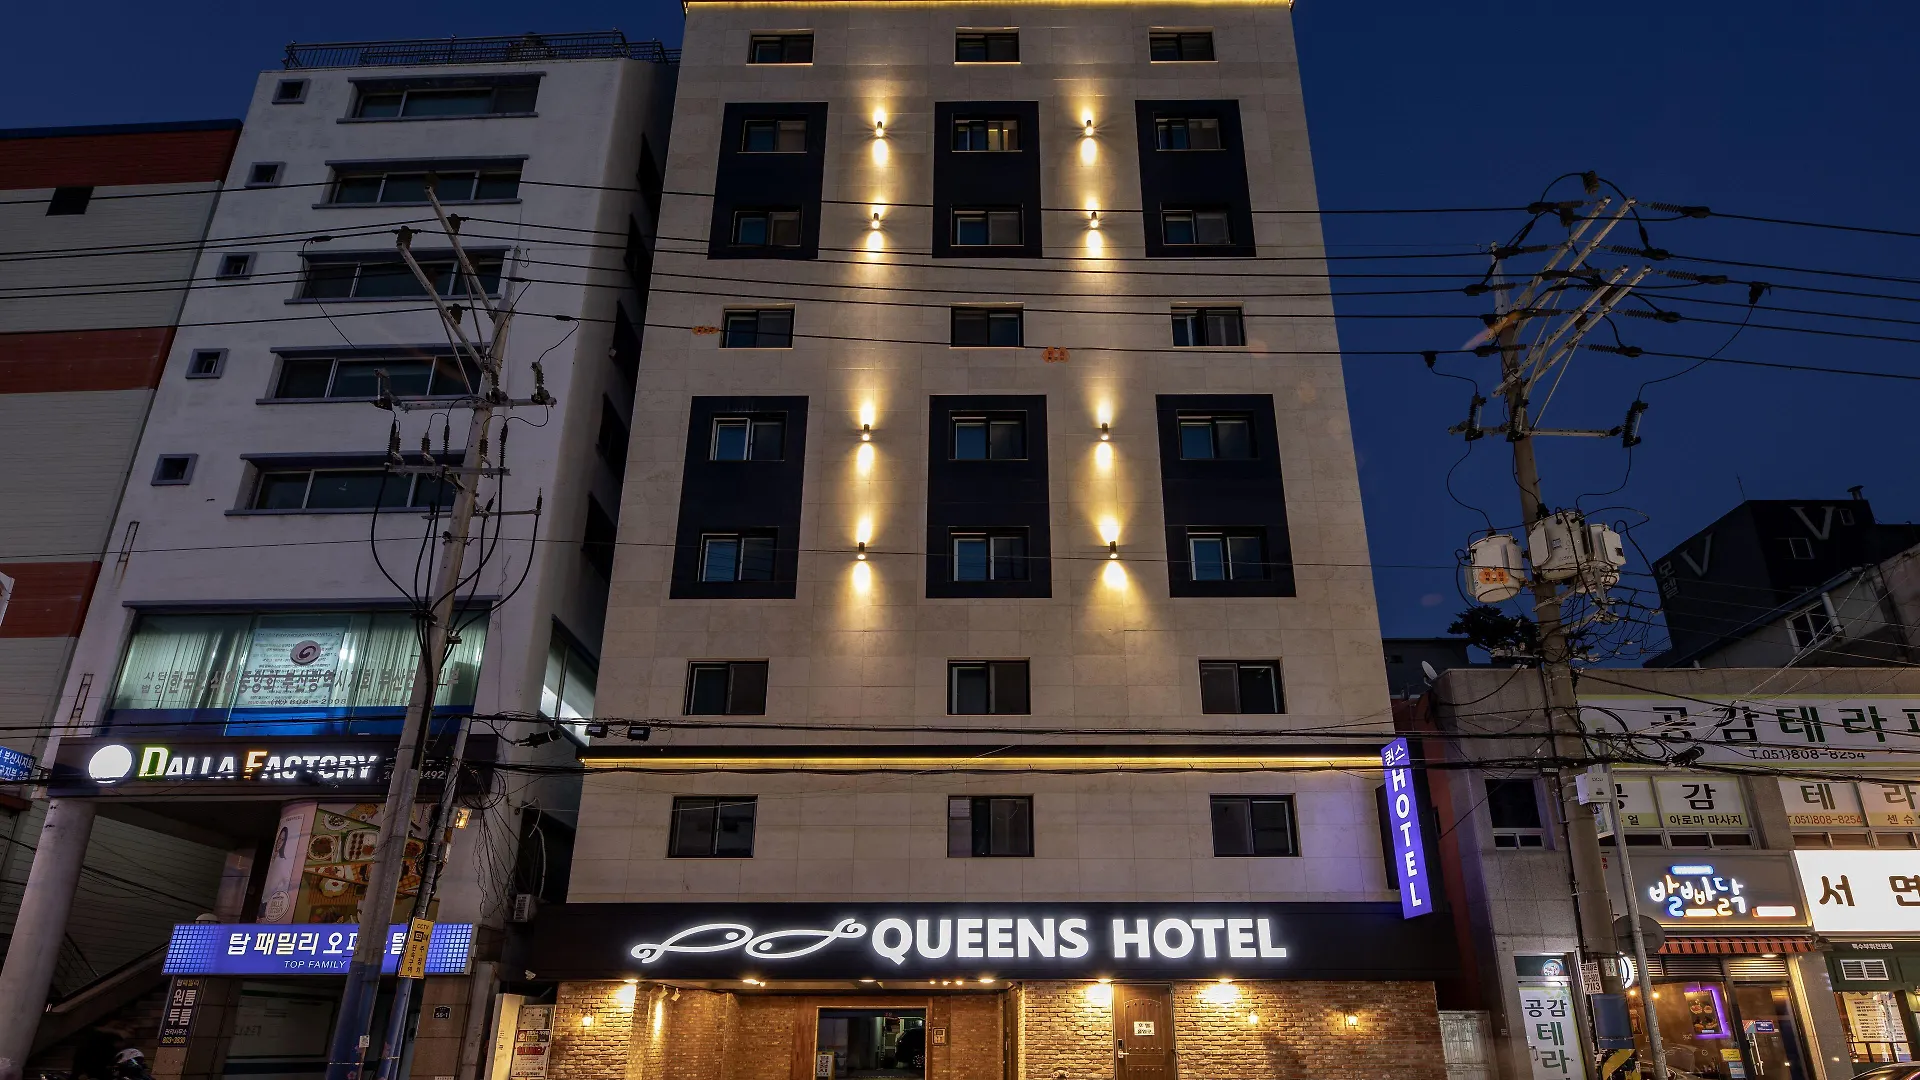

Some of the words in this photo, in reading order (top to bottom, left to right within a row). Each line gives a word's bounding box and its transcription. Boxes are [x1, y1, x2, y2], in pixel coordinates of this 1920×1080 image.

[139, 747, 236, 779] DALLA
[243, 750, 377, 779] FACTORY
[1385, 744, 1406, 766] 퀸스
[1670, 814, 1705, 826] 아로마
[1708, 814, 1744, 826] 마사지
[1392, 767, 1422, 907] HOTEL
[227, 932, 251, 957] 탑
[254, 932, 320, 957] 패밀리
[871, 918, 1090, 965] QUEENS
[1112, 918, 1287, 958] HOTEL
[284, 960, 306, 969] TOP
[308, 960, 347, 969] FAMILY
[1585, 982, 1601, 991] 7113
[173, 989, 197, 1006] 원룸
[168, 1008, 192, 1026] 투룸
[1525, 1000, 1568, 1018] 공감
